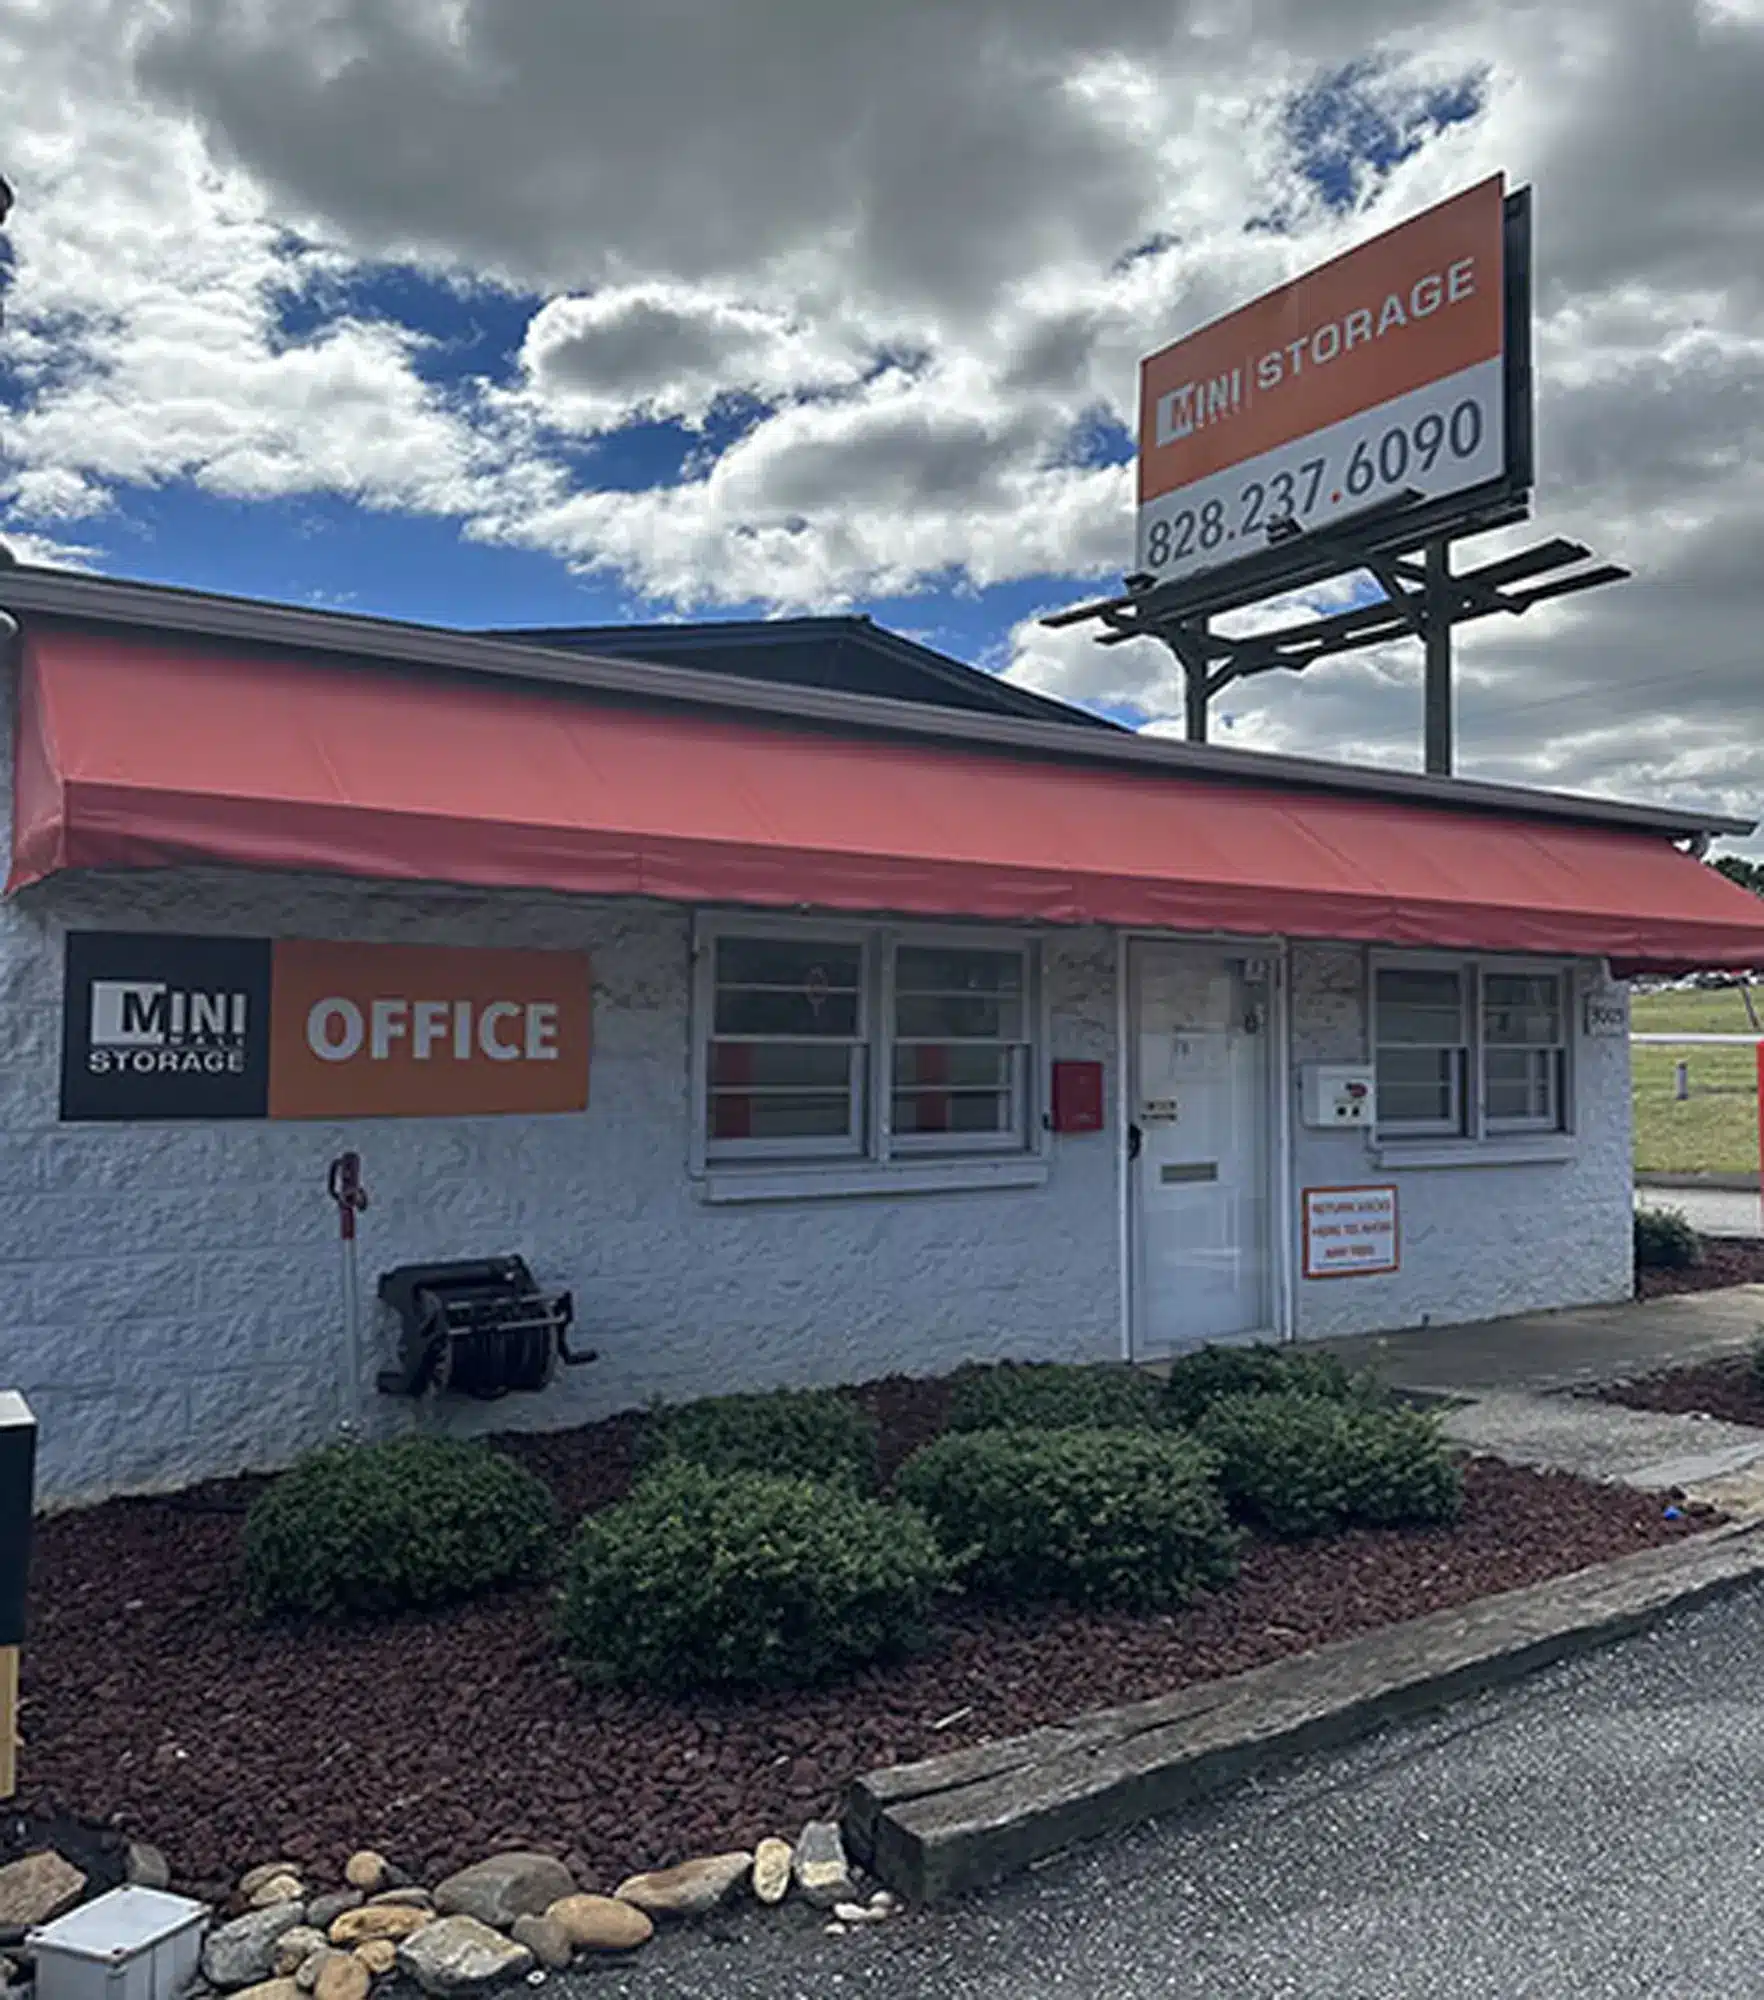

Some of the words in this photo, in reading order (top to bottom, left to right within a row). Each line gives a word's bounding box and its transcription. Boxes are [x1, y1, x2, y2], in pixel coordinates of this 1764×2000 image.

[1158, 368, 1241, 445] MINI
[1256, 256, 1476, 391] STORAGE
[1148, 399, 1483, 569] 828.237.6090
[97, 982, 246, 1038] MINI
[306, 995, 560, 1062] OFFICE
[88, 1049, 246, 1074] STORAGE
